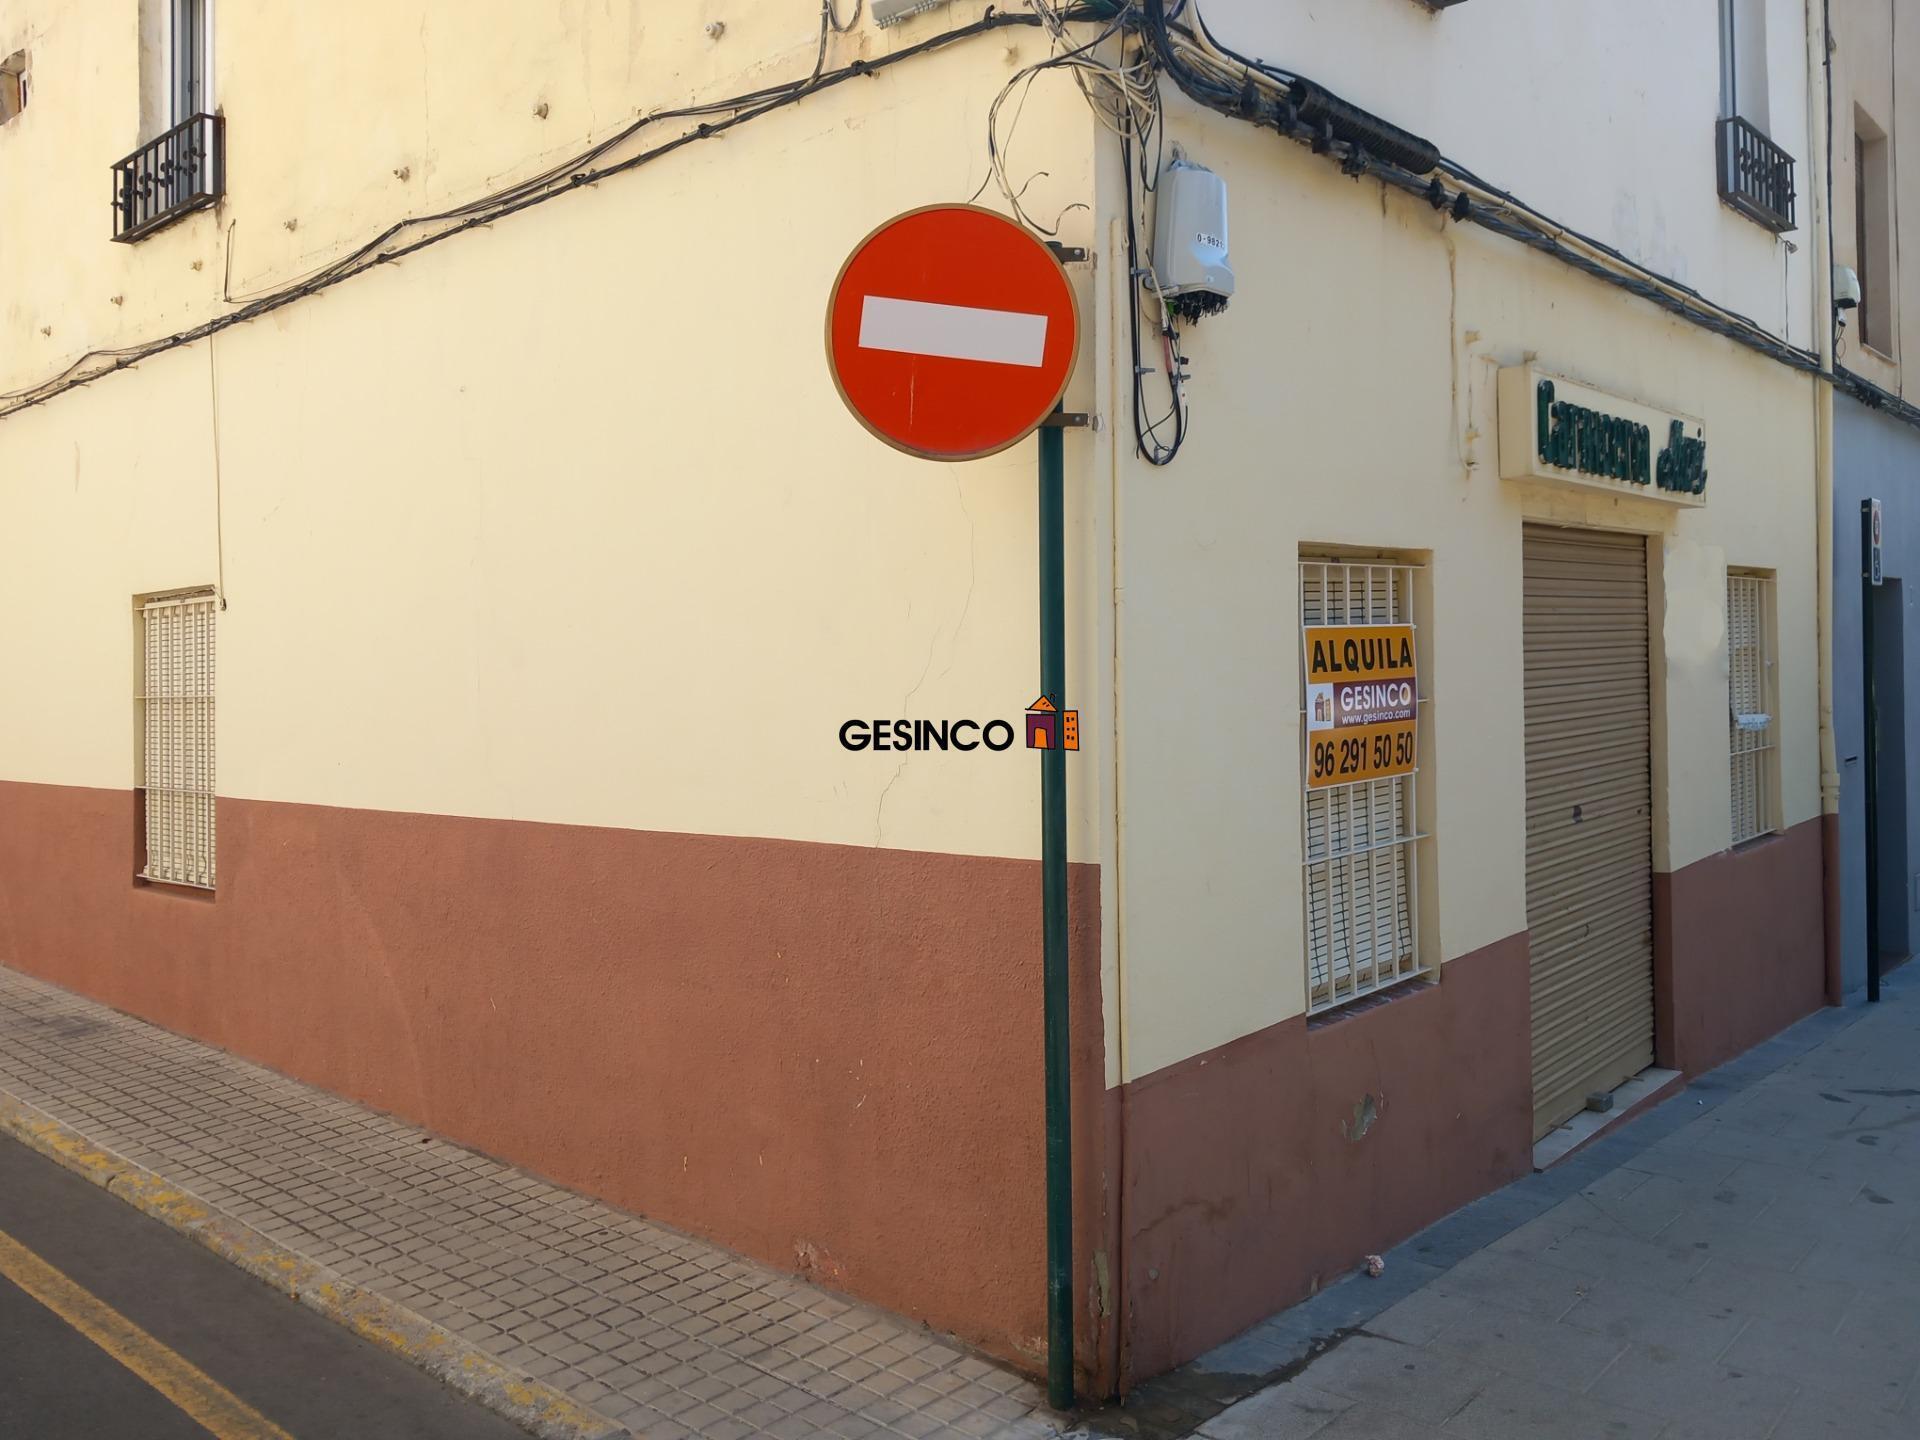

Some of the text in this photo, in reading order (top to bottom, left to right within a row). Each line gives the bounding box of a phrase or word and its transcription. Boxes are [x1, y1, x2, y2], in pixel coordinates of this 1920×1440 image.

[1312, 638, 1413, 674] ALQUILA
[1341, 682, 1411, 711] GESINCO
[1342, 709, 1411, 725] www.gesinco.com
[1315, 731, 1413, 778] 96 291 50 50
